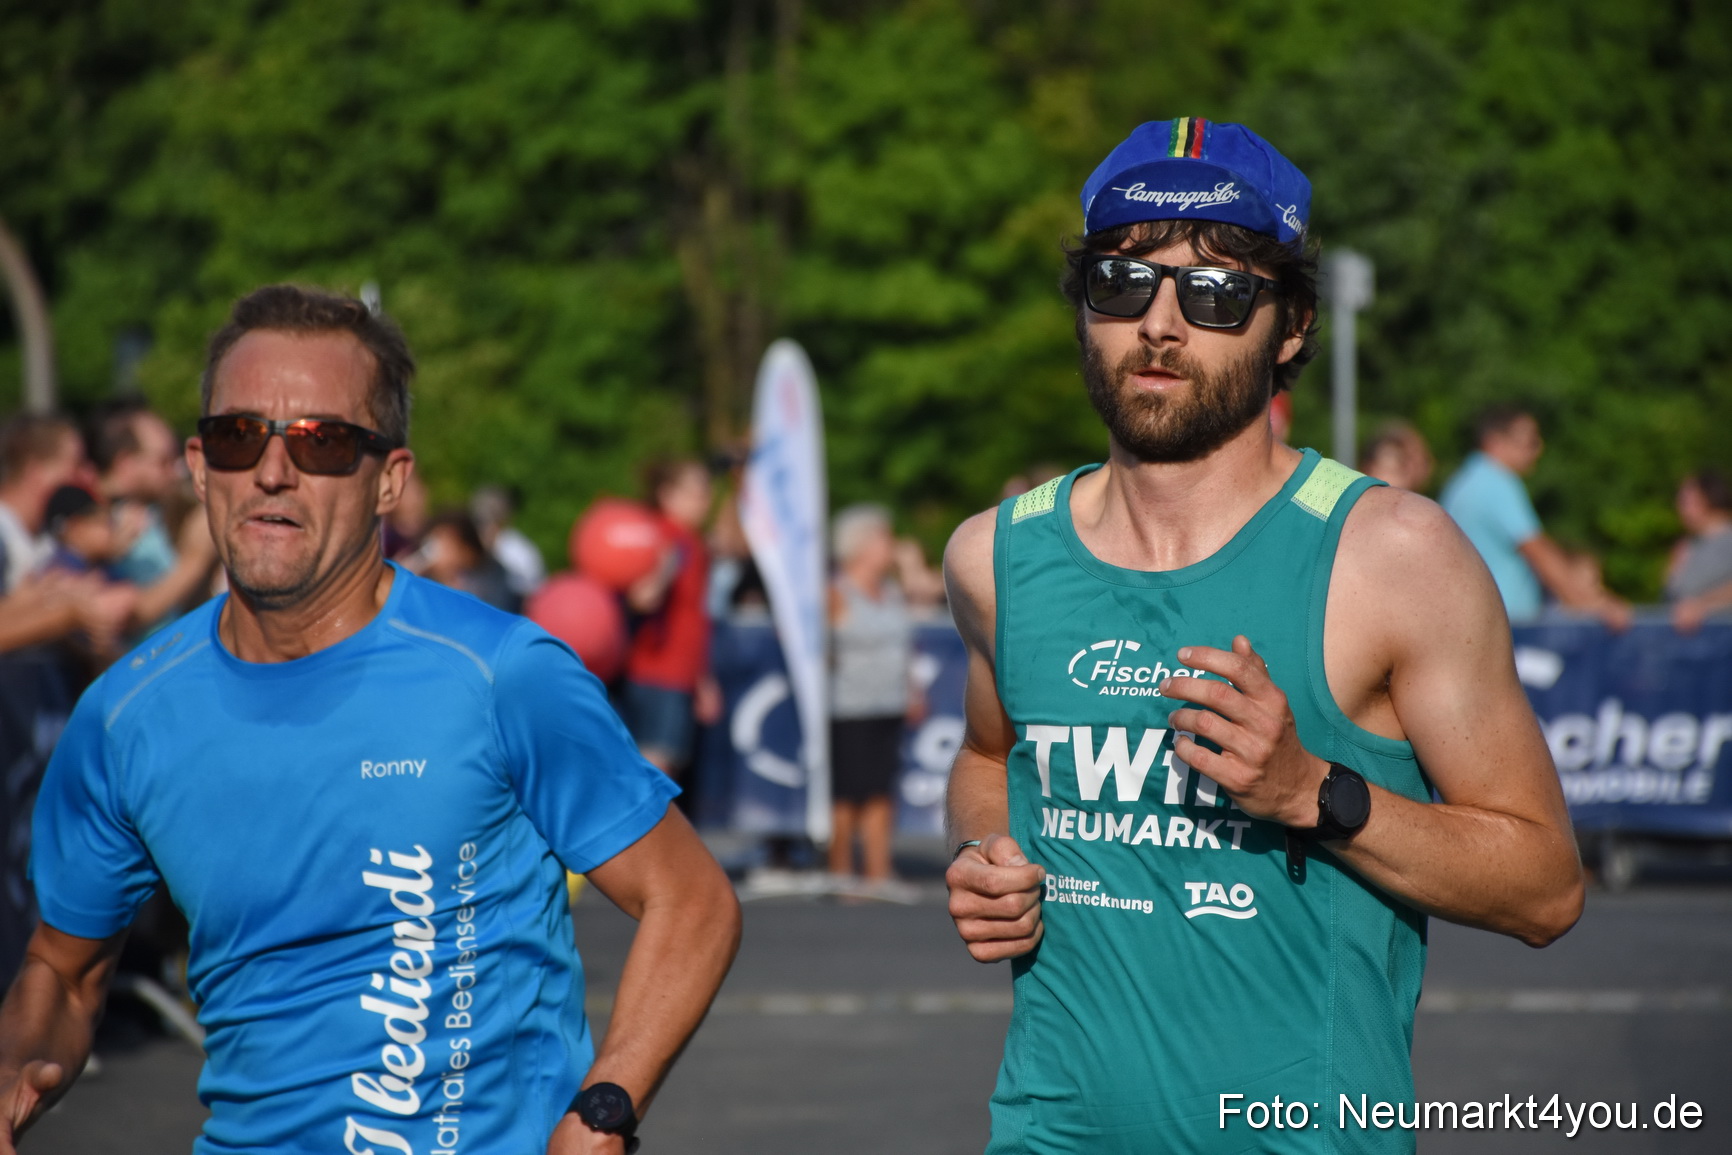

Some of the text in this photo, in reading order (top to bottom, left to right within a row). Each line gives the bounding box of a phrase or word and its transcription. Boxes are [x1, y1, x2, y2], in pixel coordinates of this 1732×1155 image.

[1090, 660, 1206, 684] Fischer
[1098, 686, 1165, 698] AUTOMO
[1541, 698, 1732, 772] cher
[361, 758, 427, 780] Ronny
[1041, 807, 1252, 851] NEUMARKT
[1184, 882, 1255, 909] TAO
[351, 845, 436, 1115] bediendi
